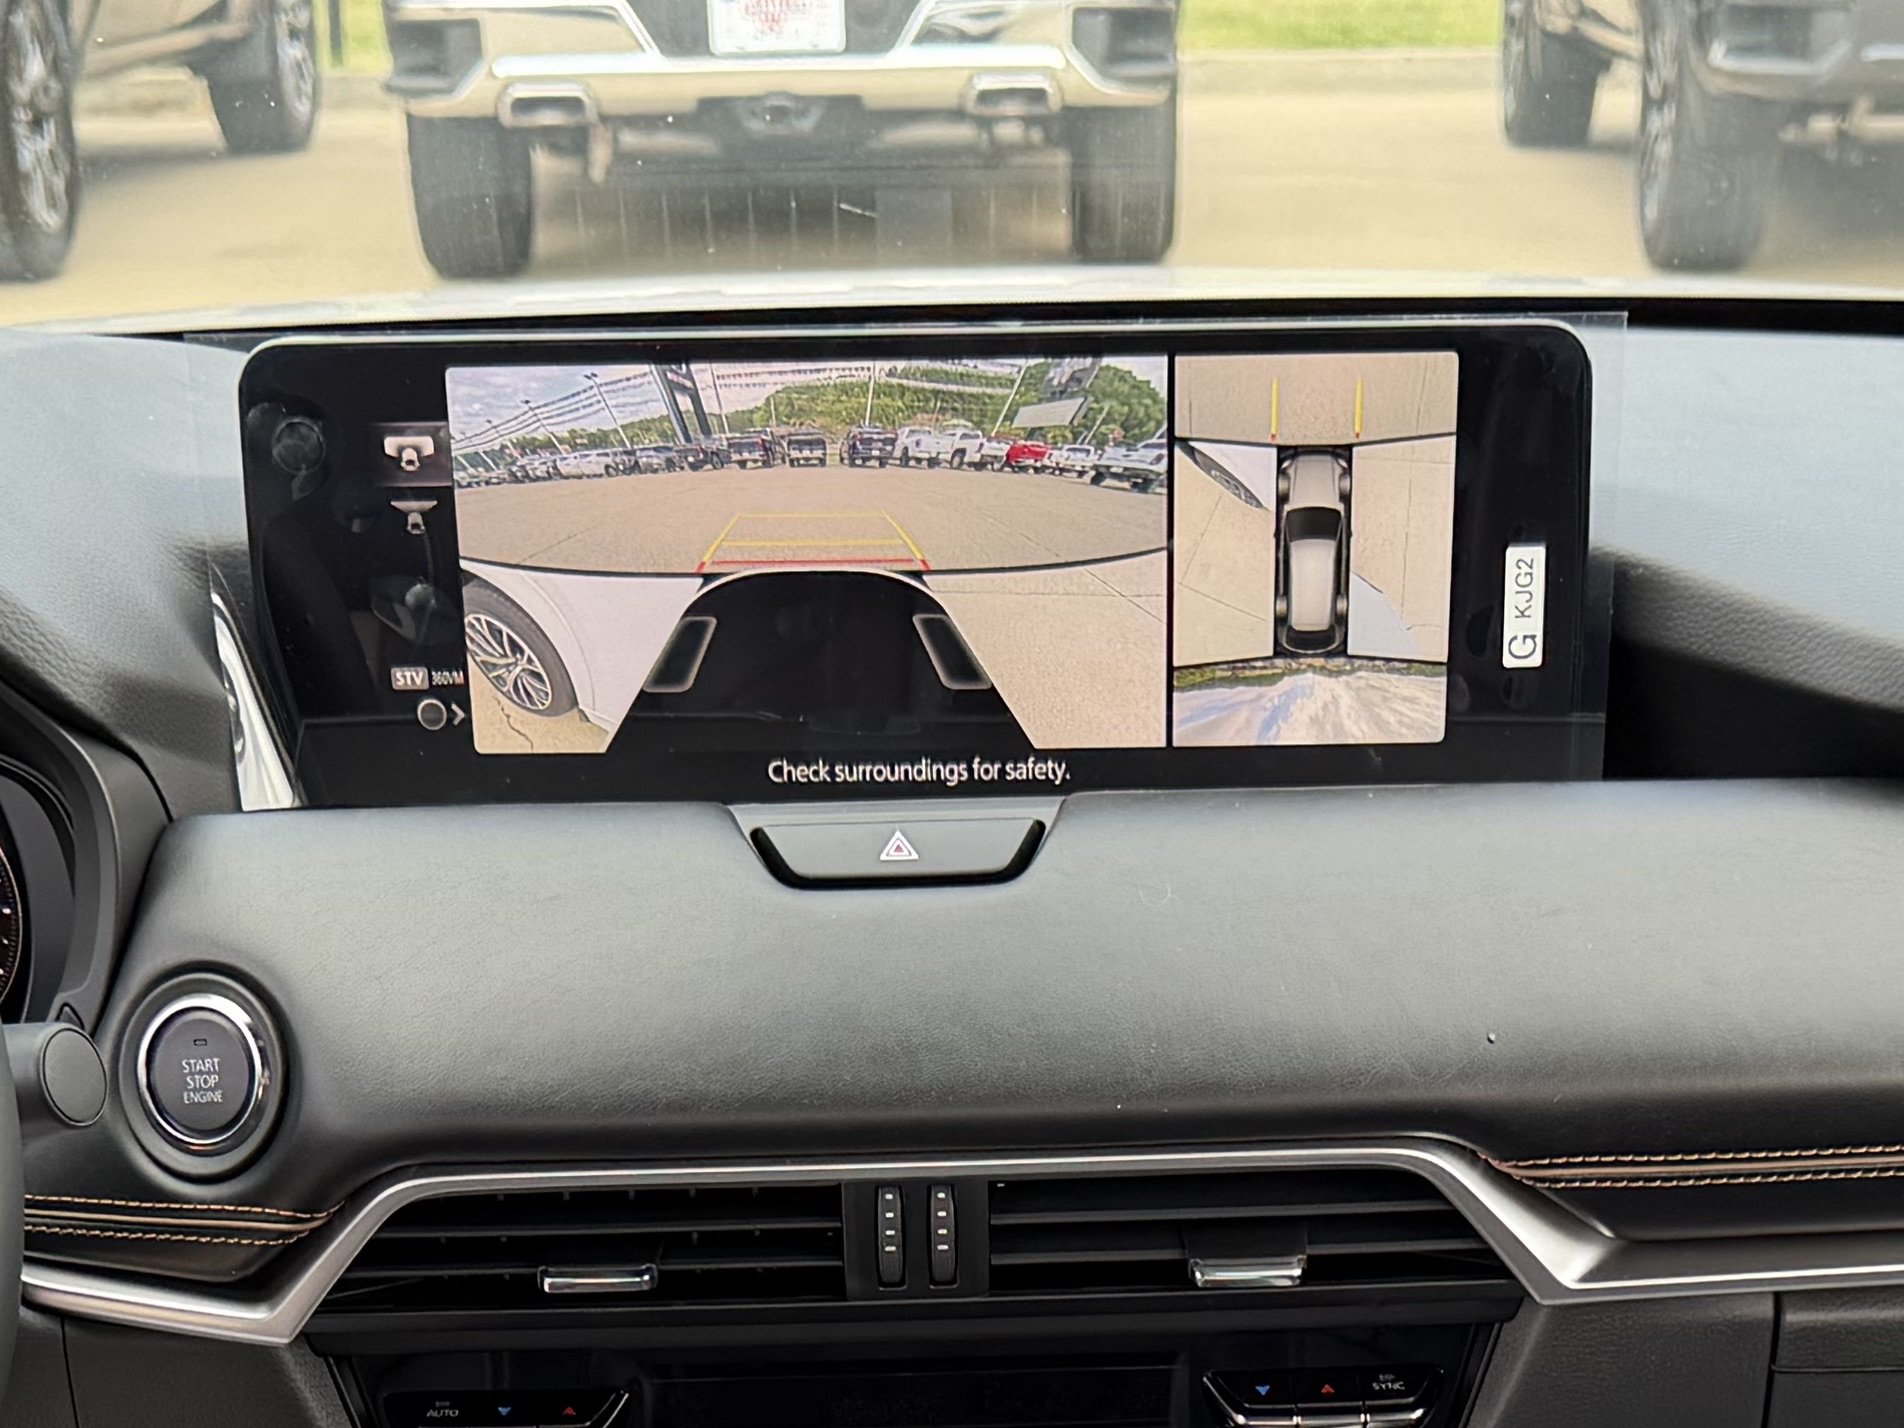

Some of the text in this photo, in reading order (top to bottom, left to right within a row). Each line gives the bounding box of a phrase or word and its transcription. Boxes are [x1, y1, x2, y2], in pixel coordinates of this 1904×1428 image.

[1508, 558, 1537, 660] G KJG2
[395, 671, 424, 687] STV
[767, 756, 1072, 786] Check surroundings for safety.
[182, 1058, 220, 1073] START
[186, 1074, 219, 1089] STOP
[183, 1089, 223, 1104] ENGINE
